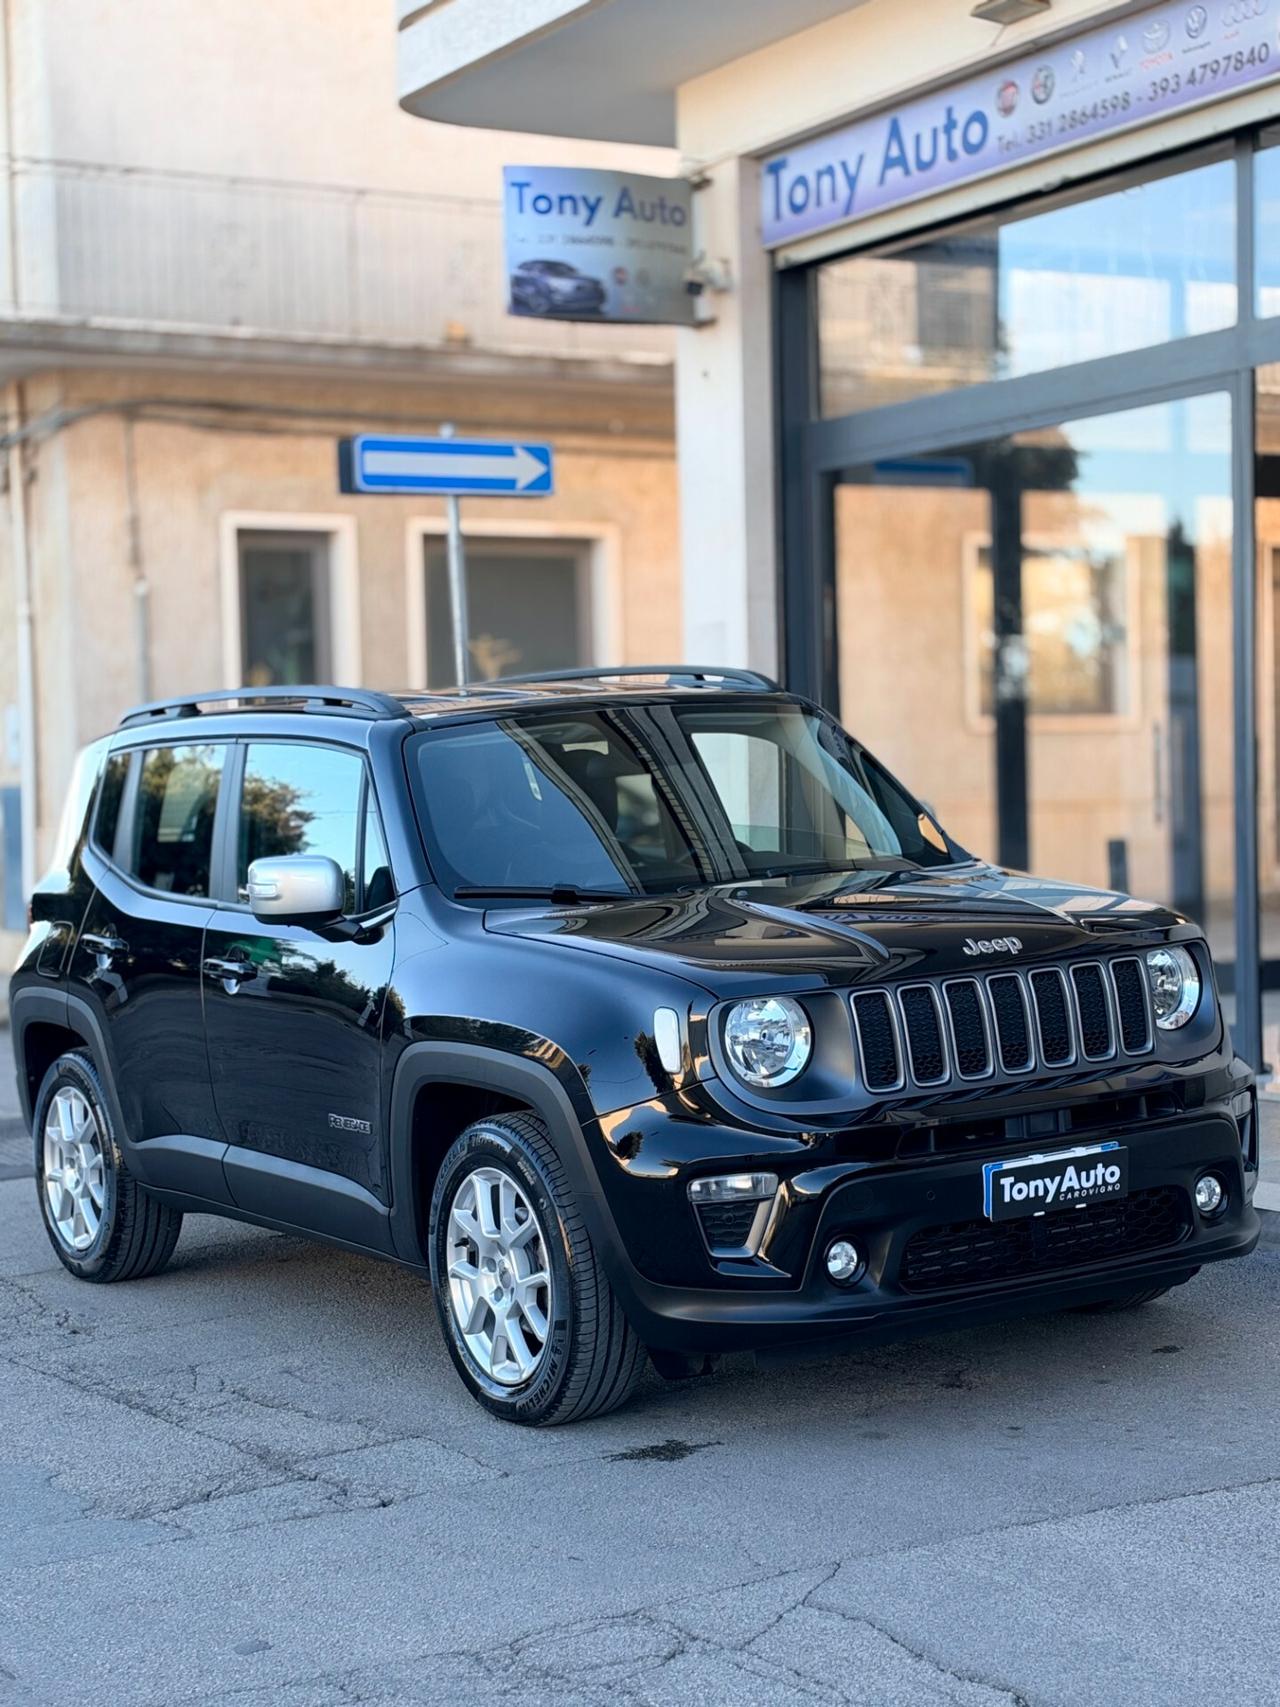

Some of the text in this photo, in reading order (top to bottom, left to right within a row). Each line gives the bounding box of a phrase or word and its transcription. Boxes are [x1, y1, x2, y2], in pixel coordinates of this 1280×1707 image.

[1025, 119, 1053, 145] 331
[1148, 73, 1181, 101] 393
[1186, 41, 1270, 87] 4797840
[766, 105, 989, 222] Tony Auto
[510, 181, 687, 228] Tony Auto
[962, 936, 1023, 956] Jeep
[1000, 1162, 1122, 1203] TonyAuto
[1059, 1182, 1121, 1201] CAROVIGNO
